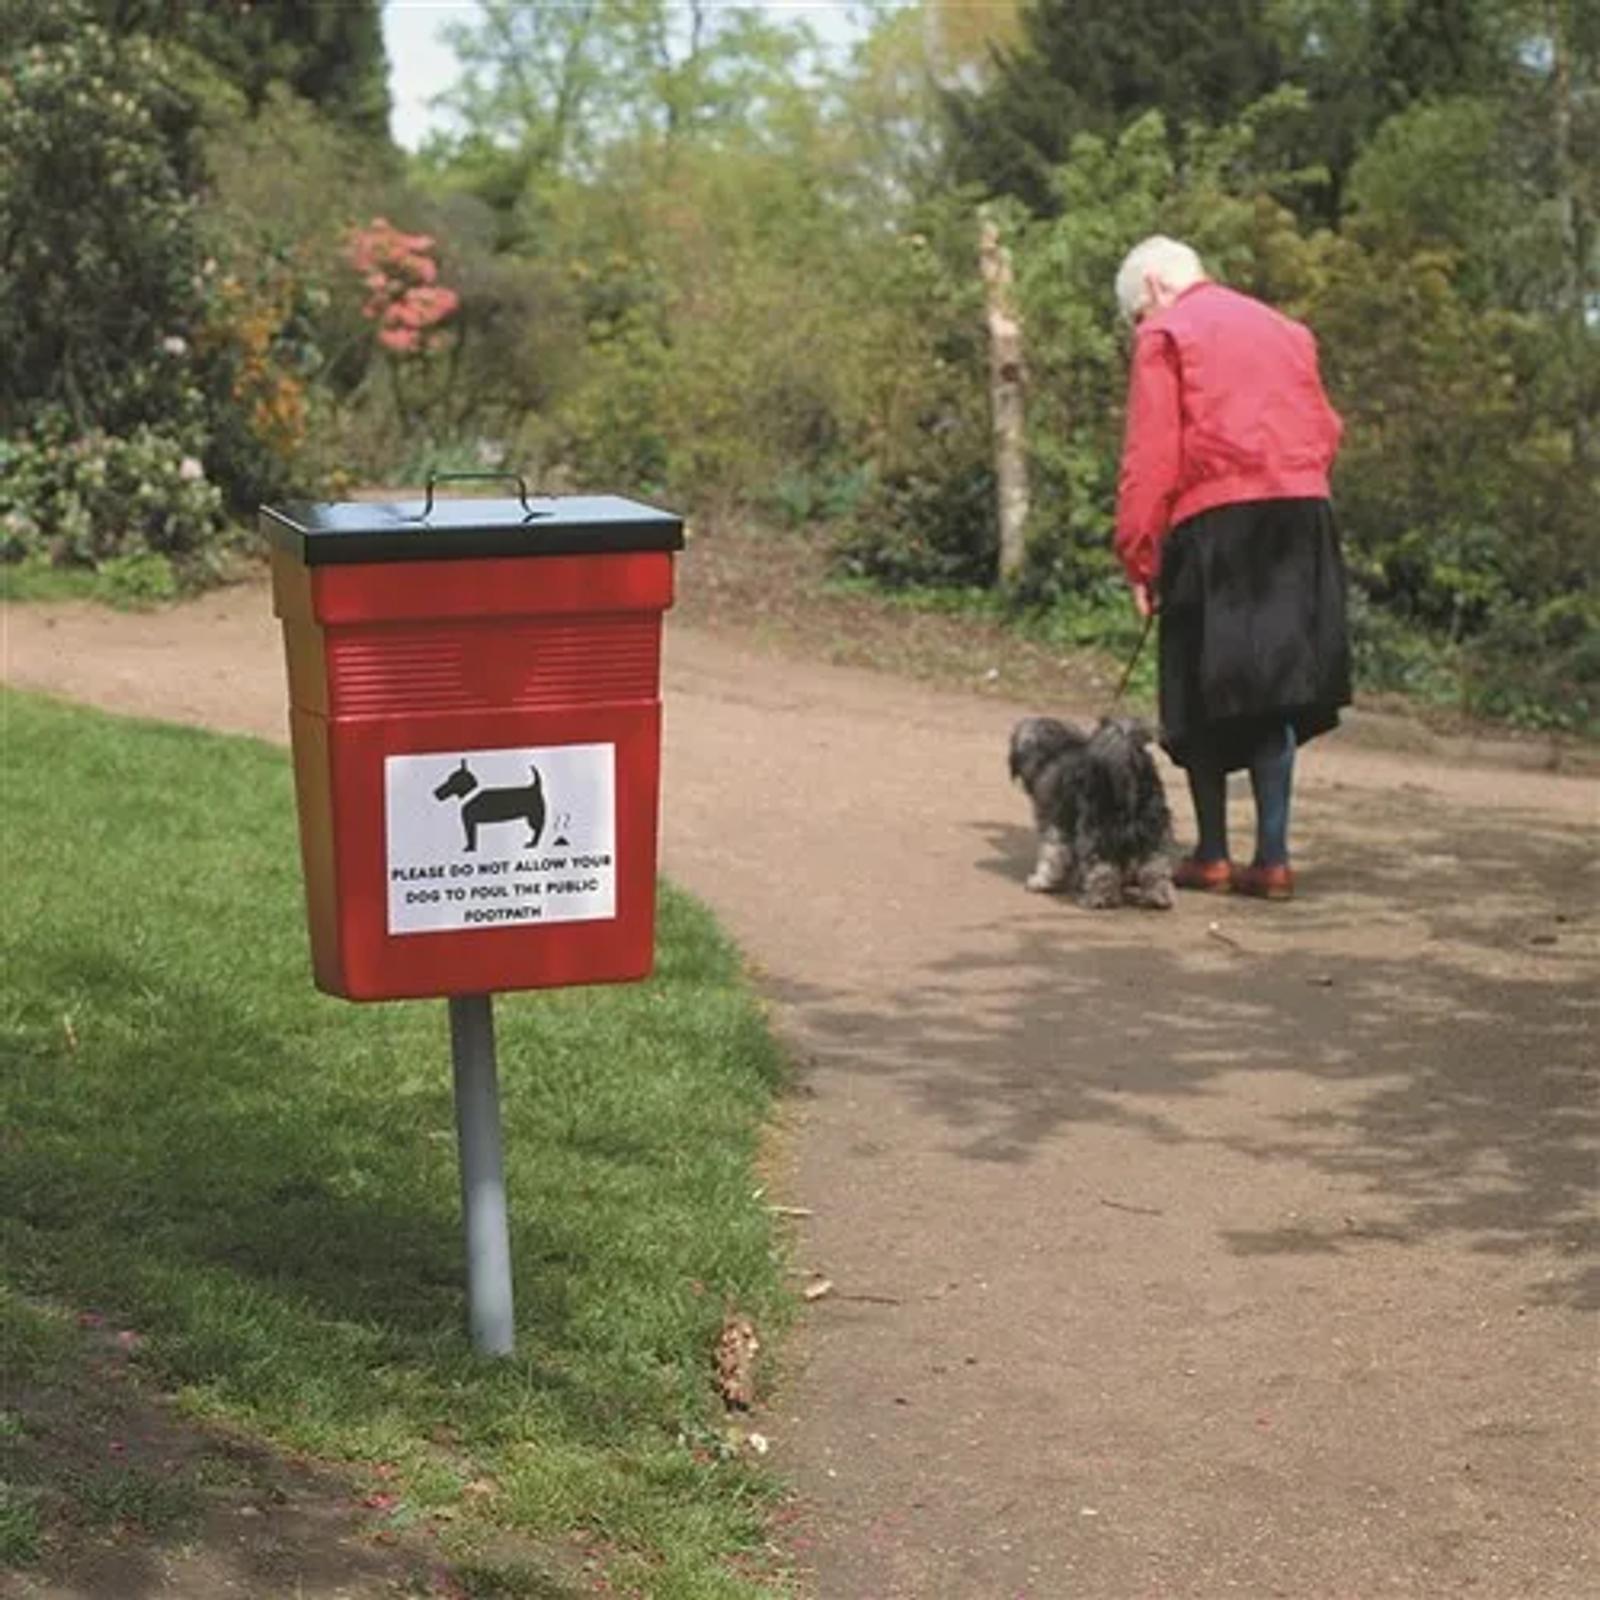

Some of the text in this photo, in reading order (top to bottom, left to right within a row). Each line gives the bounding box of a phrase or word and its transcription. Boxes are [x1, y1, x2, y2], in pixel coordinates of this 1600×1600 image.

[392, 854, 611, 881] PLEASE DO NOT ALLOW YOUR
[405, 878, 599, 904] DOG TO FOUL THE PUBLIC
[464, 906, 542, 923] FOOTPATH
